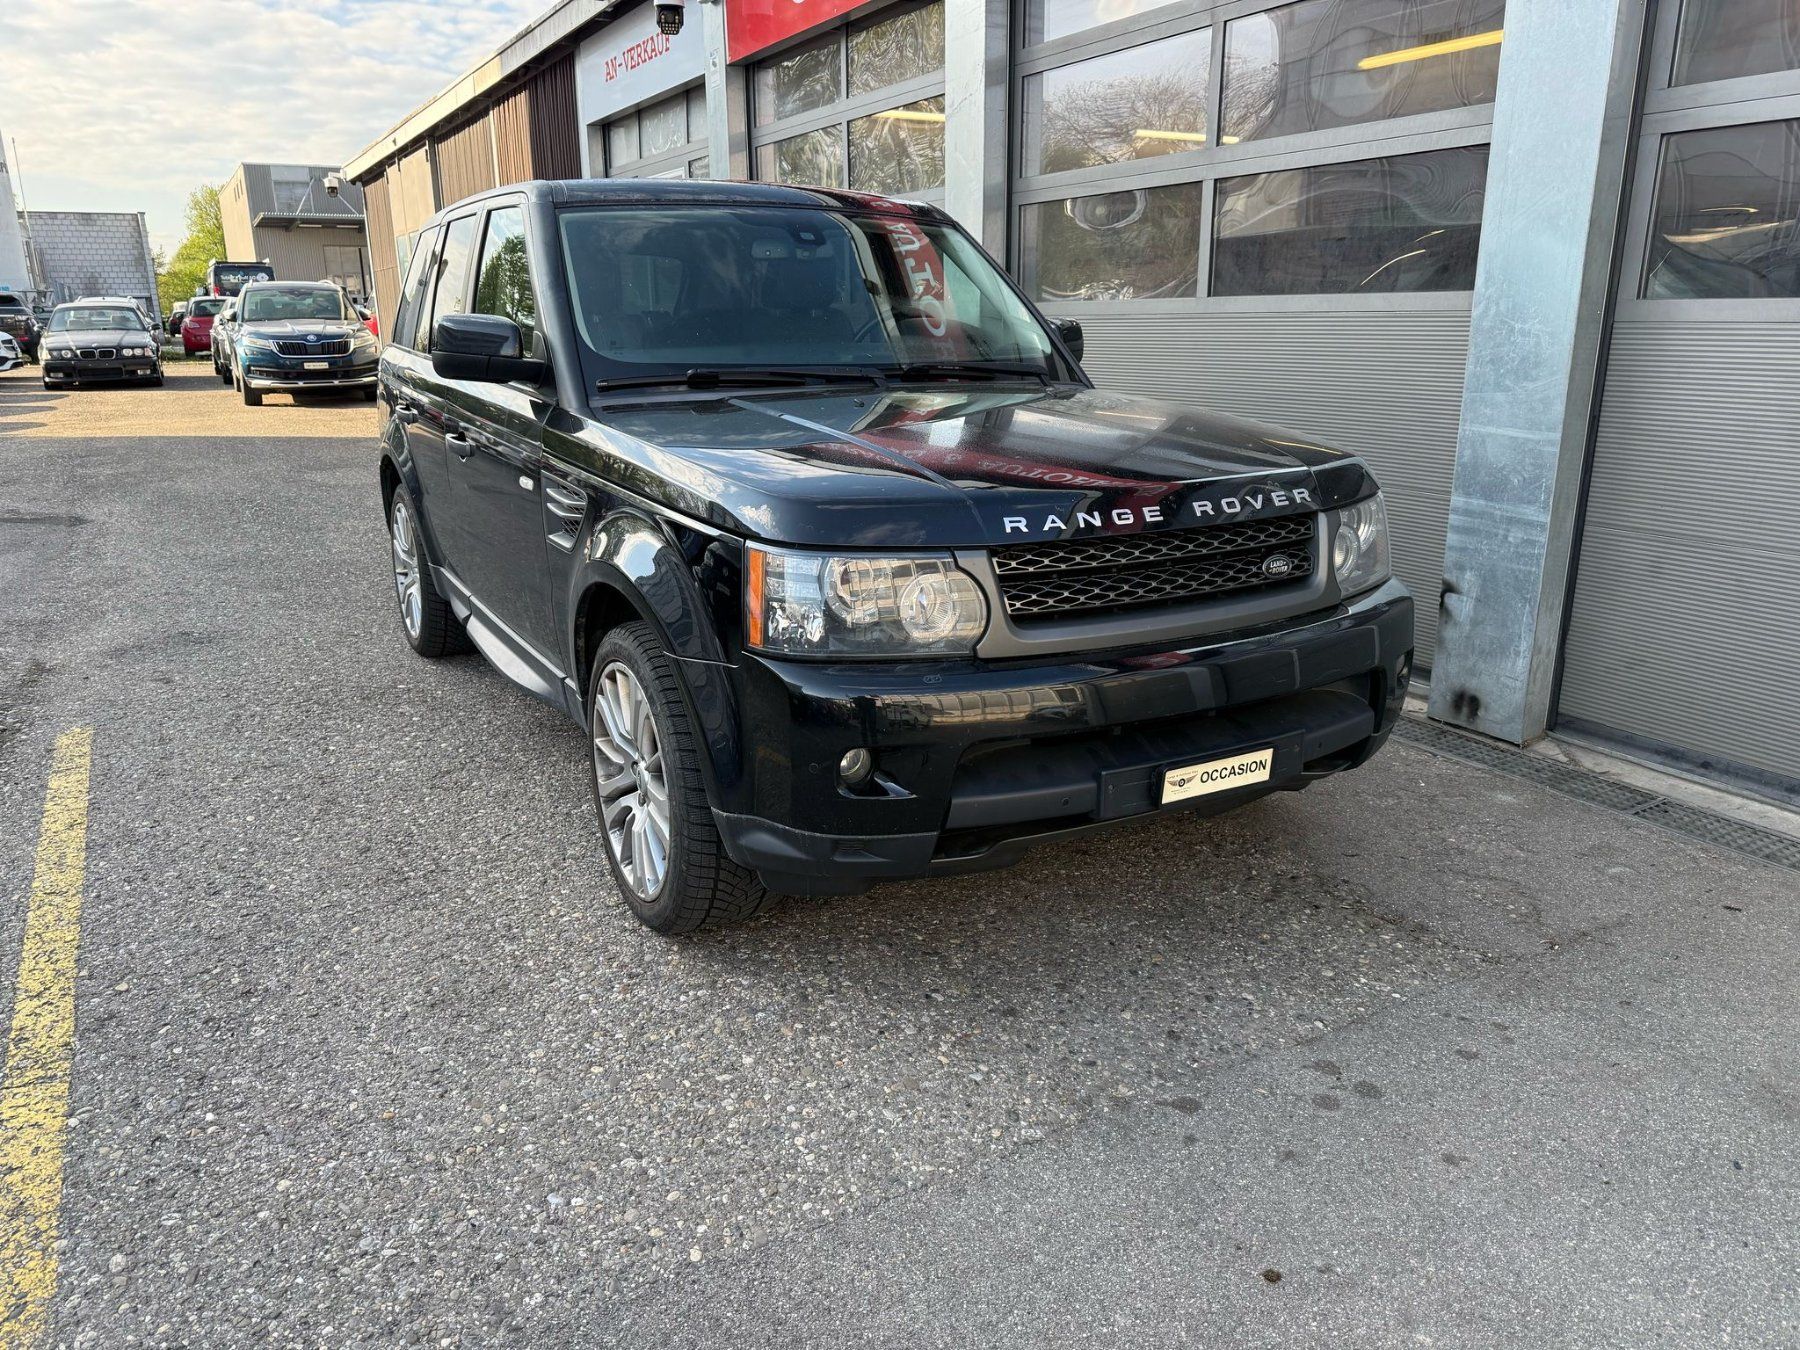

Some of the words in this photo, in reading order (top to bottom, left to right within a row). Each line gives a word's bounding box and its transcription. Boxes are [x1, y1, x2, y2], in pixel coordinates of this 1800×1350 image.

[604, 32, 671, 82] AN-VERKAUF
[1002, 505, 1164, 534] RANGE
[1192, 488, 1312, 518] ROVER
[1200, 758, 1268, 784] OCCASION
